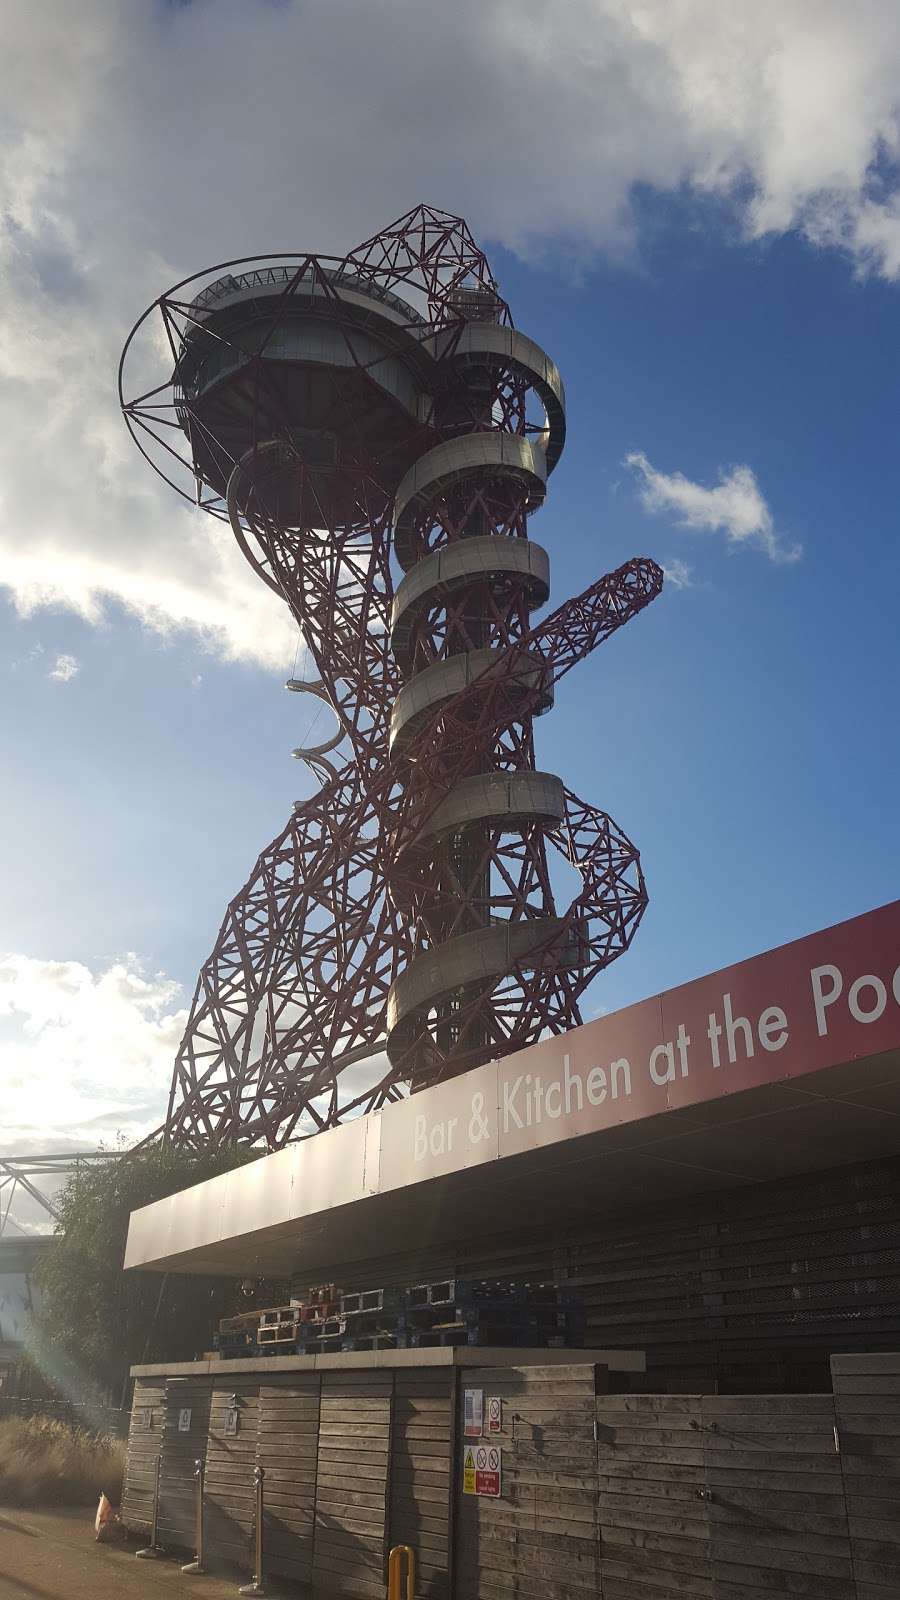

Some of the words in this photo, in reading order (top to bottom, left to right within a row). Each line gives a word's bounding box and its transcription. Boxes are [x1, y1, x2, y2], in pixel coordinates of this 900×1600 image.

[413, 1114, 458, 1162] Bar
[467, 1091, 491, 1144] &
[502, 1054, 632, 1134] Kitchen
[649, 1023, 691, 1086] at
[708, 993, 790, 1069] the
[810, 964, 900, 1037] Po
